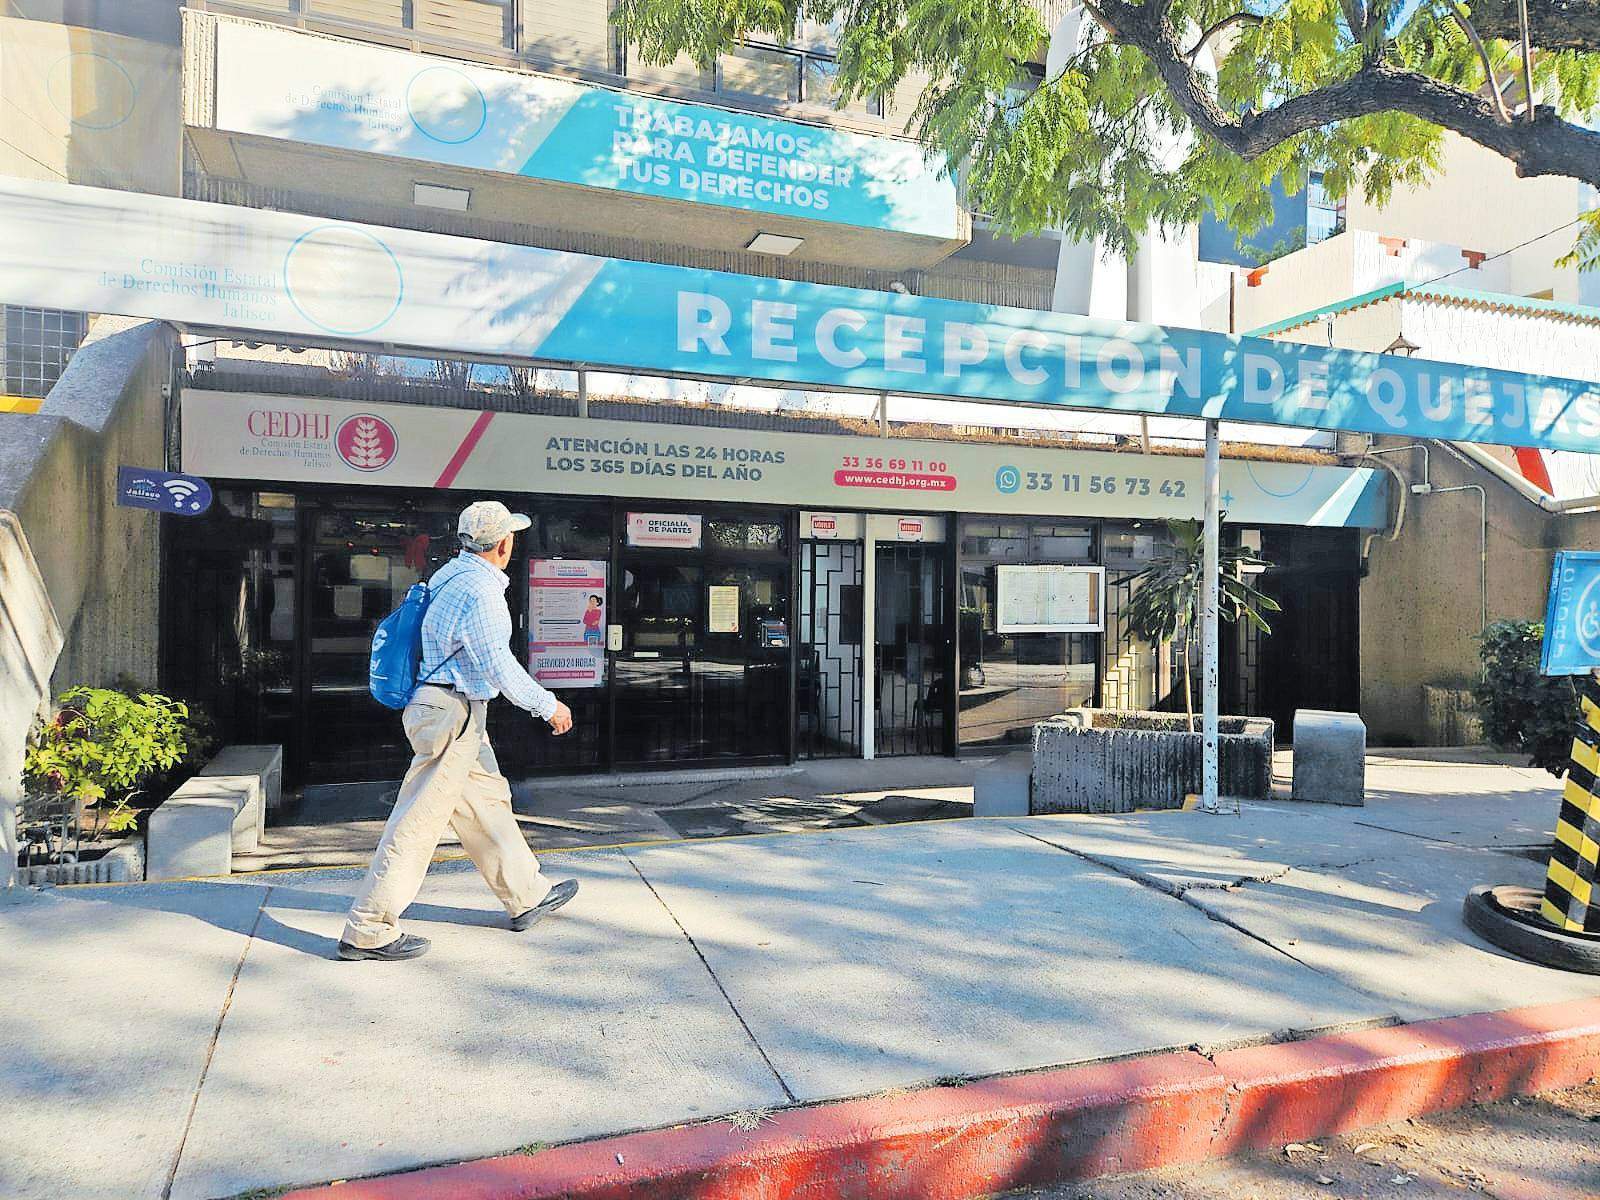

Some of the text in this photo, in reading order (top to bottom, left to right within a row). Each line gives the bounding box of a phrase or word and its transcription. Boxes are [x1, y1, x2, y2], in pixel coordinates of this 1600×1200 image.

[613, 105, 812, 158] TRABAJAMOS
[613, 131, 851, 188] PARA DEFENDER
[617, 158, 829, 210] TUS DERECHOS
[141, 258, 277, 289] Comisión Estatal
[97, 271, 277, 306] de Derechos Humanos
[222, 302, 277, 321] Jalisco
[677, 290, 1600, 438] RECEPCIÓN DE QUEJAS
[248, 410, 332, 440] CEDHJ
[239, 446, 331, 459] de Derechos Humanos
[260, 437, 331, 450] Comisión Estatal
[546, 437, 785, 464] ATENCIÓN LAS 24 HORAS
[303, 458, 332, 468] Jalisco
[546, 456, 763, 482] LOS 365 DÍAS DEL AÑO
[843, 456, 946, 472] 33 36 69 11 00
[844, 475, 946, 488] www.cedhj.org.mx
[1026, 472, 1186, 498] 33 11 56 73 42
[648, 519, 689, 527] OFICIALÍA
[537, 656, 566, 668] SERVICIO
[575, 656, 597, 668] HORAS
